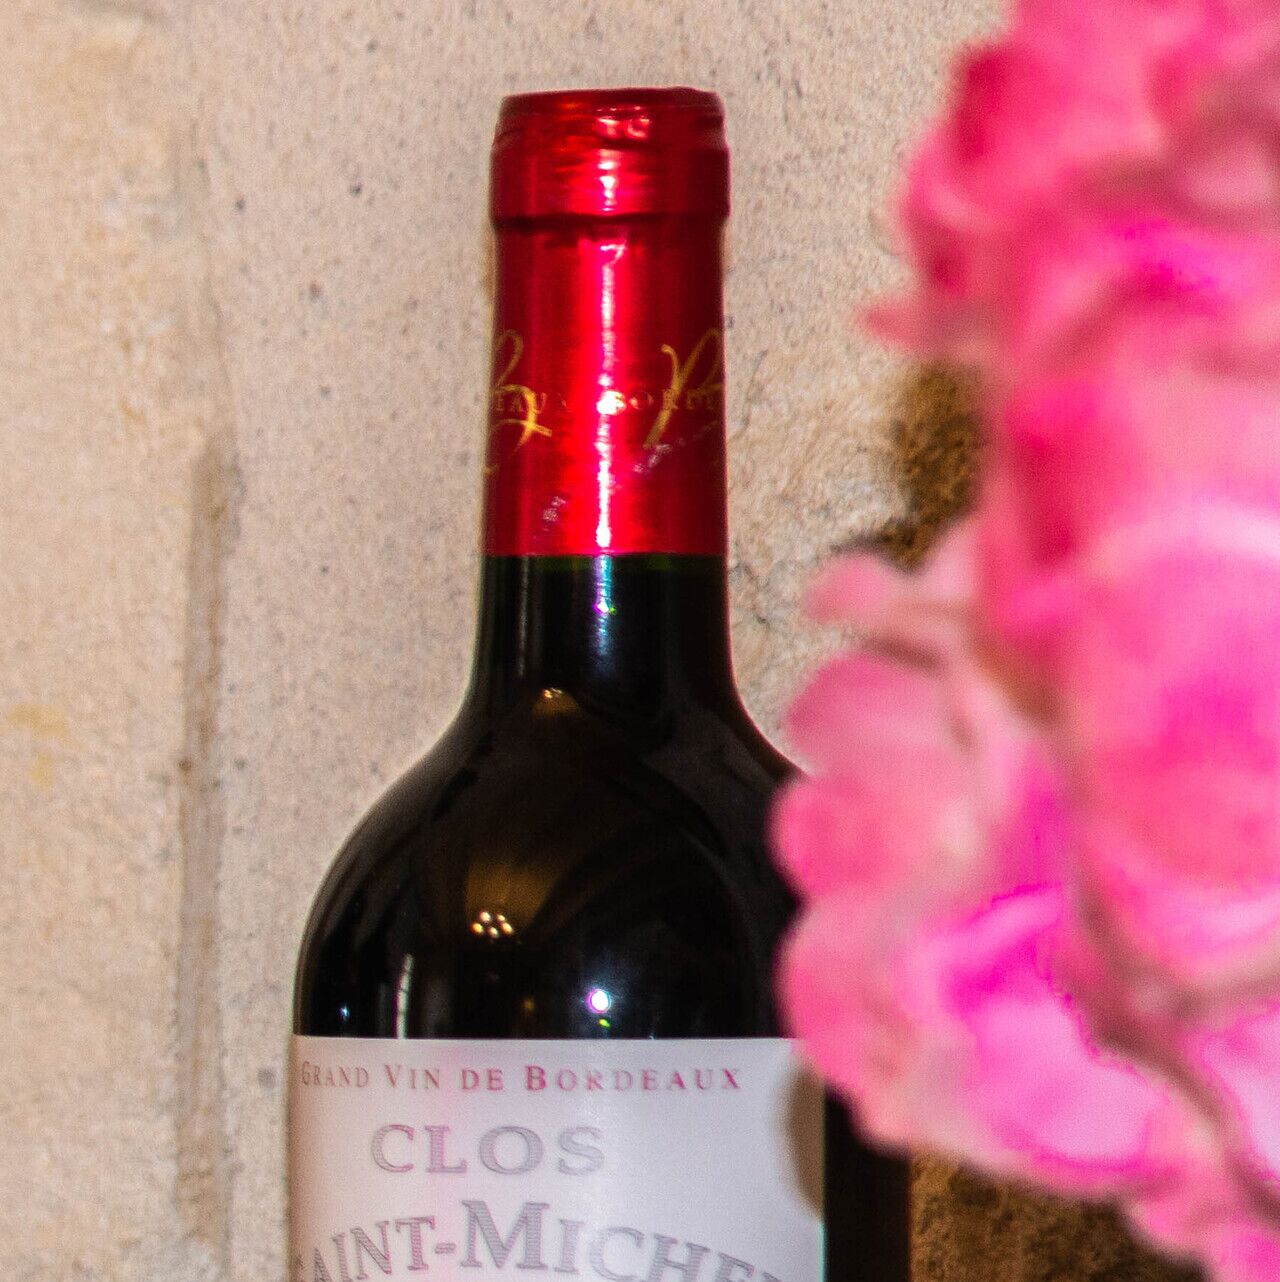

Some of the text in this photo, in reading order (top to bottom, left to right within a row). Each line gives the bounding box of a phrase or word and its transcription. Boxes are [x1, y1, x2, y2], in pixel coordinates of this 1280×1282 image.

[301, 1061, 742, 1092] GRAND VIN DE BORDEAUX
[371, 1124, 605, 1176] CLOS
